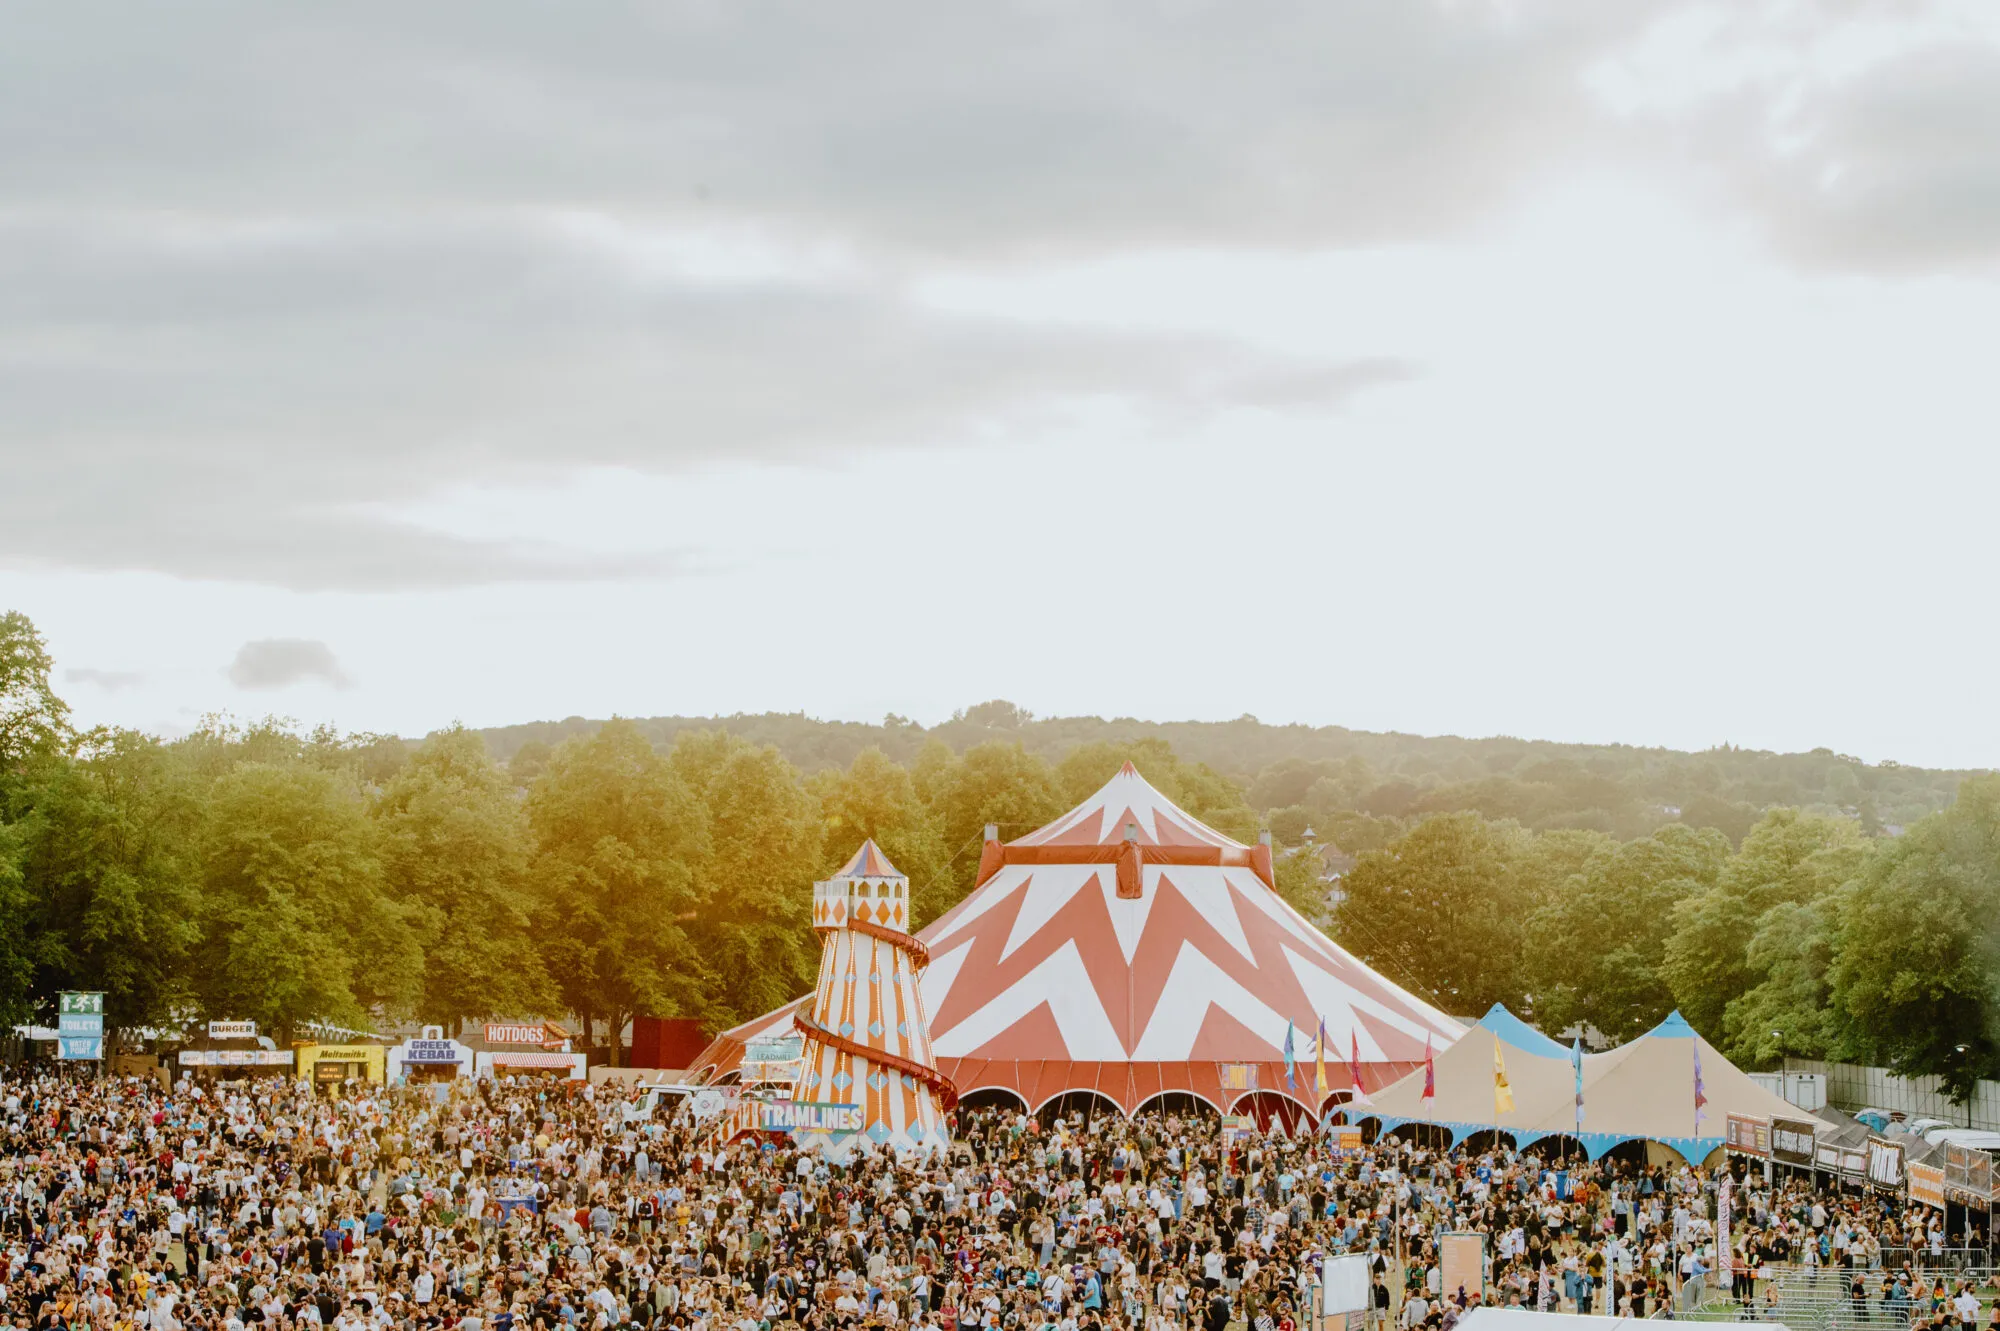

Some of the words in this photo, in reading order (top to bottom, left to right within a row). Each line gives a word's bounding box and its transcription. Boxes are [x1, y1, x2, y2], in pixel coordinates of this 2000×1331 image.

[62, 1020, 100, 1031] TOILETS
[211, 1025, 253, 1033] BURGER
[488, 1026, 544, 1043] HOTDOGS
[69, 1040, 91, 1048] WATER
[411, 1040, 451, 1050] GREEK
[70, 1047, 90, 1055] POINT
[408, 1049, 456, 1060] KEBAB
[761, 1104, 864, 1130] TRAMLINES
